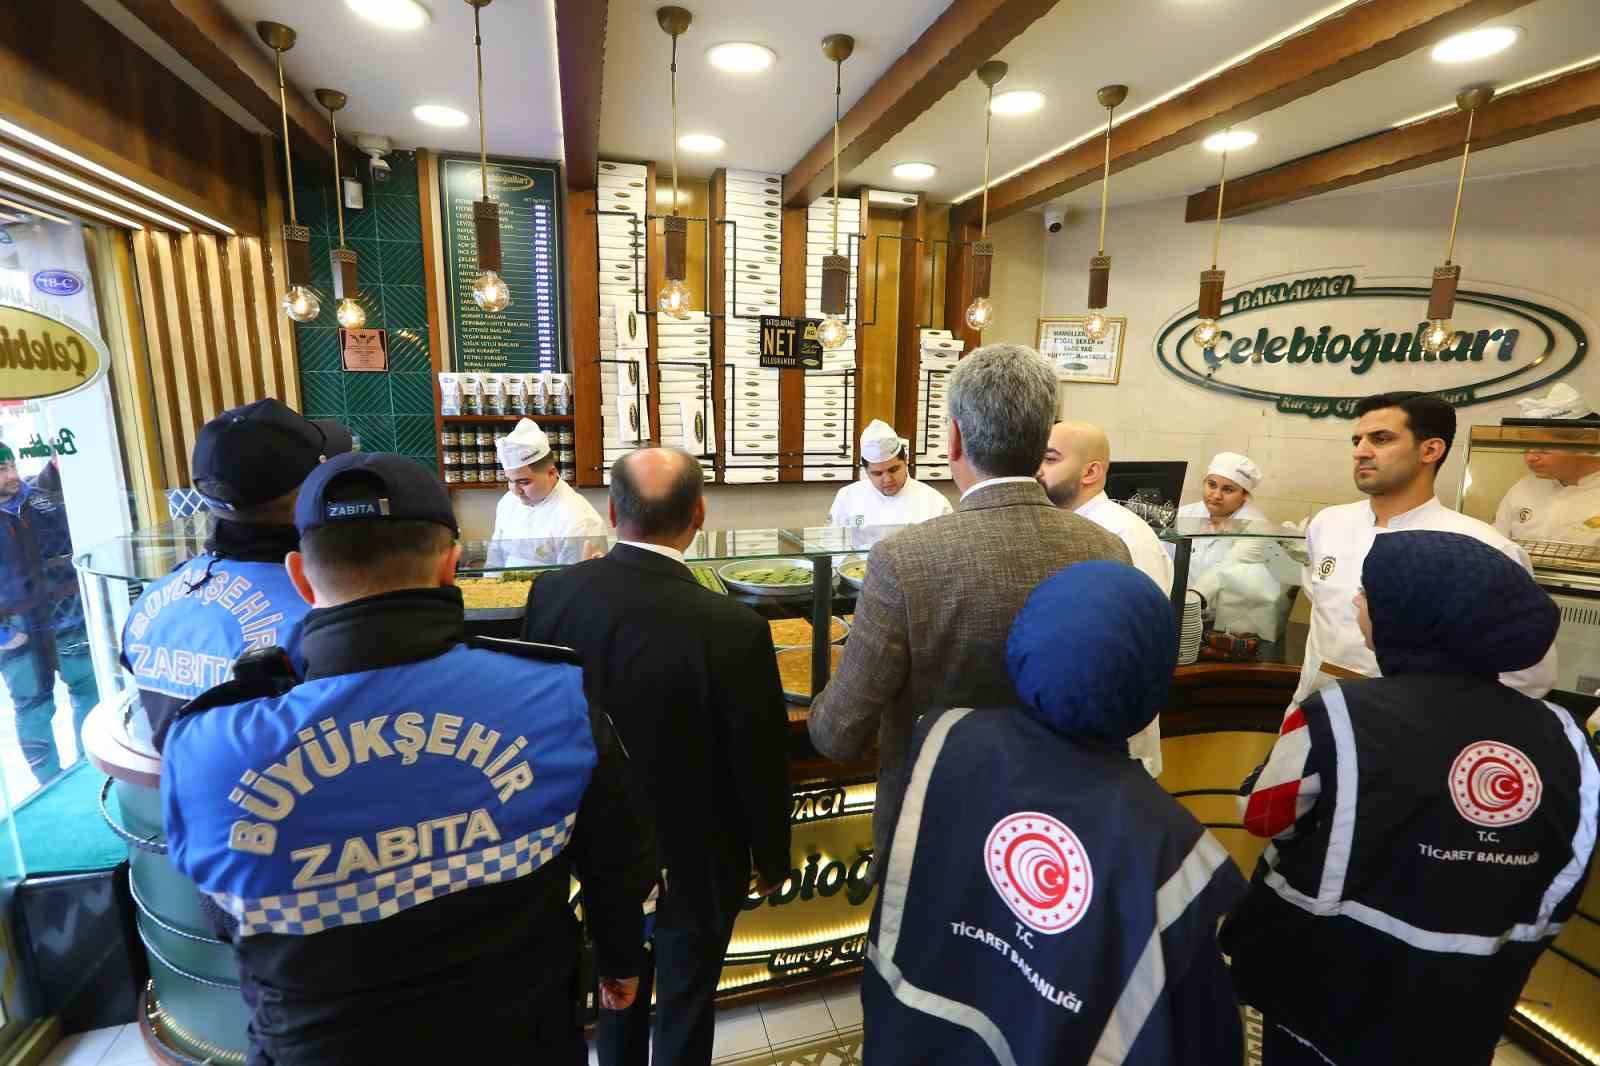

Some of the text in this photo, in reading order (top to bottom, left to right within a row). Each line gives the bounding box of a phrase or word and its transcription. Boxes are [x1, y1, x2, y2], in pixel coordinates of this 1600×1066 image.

[1238, 278, 1351, 310] BAKLAVACI
[764, 328, 796, 356] NET
[329, 503, 376, 517] ZABITA
[128, 643, 237, 691] ZABIT
[228, 712, 534, 855] BÜYÜKŞEHİR
[291, 808, 502, 890] ZABITA
[1418, 843, 1475, 861] TİCARET
[841, 938, 865, 957] Çif
[951, 921, 1082, 1014] TİCARET BAKANLIĞI
